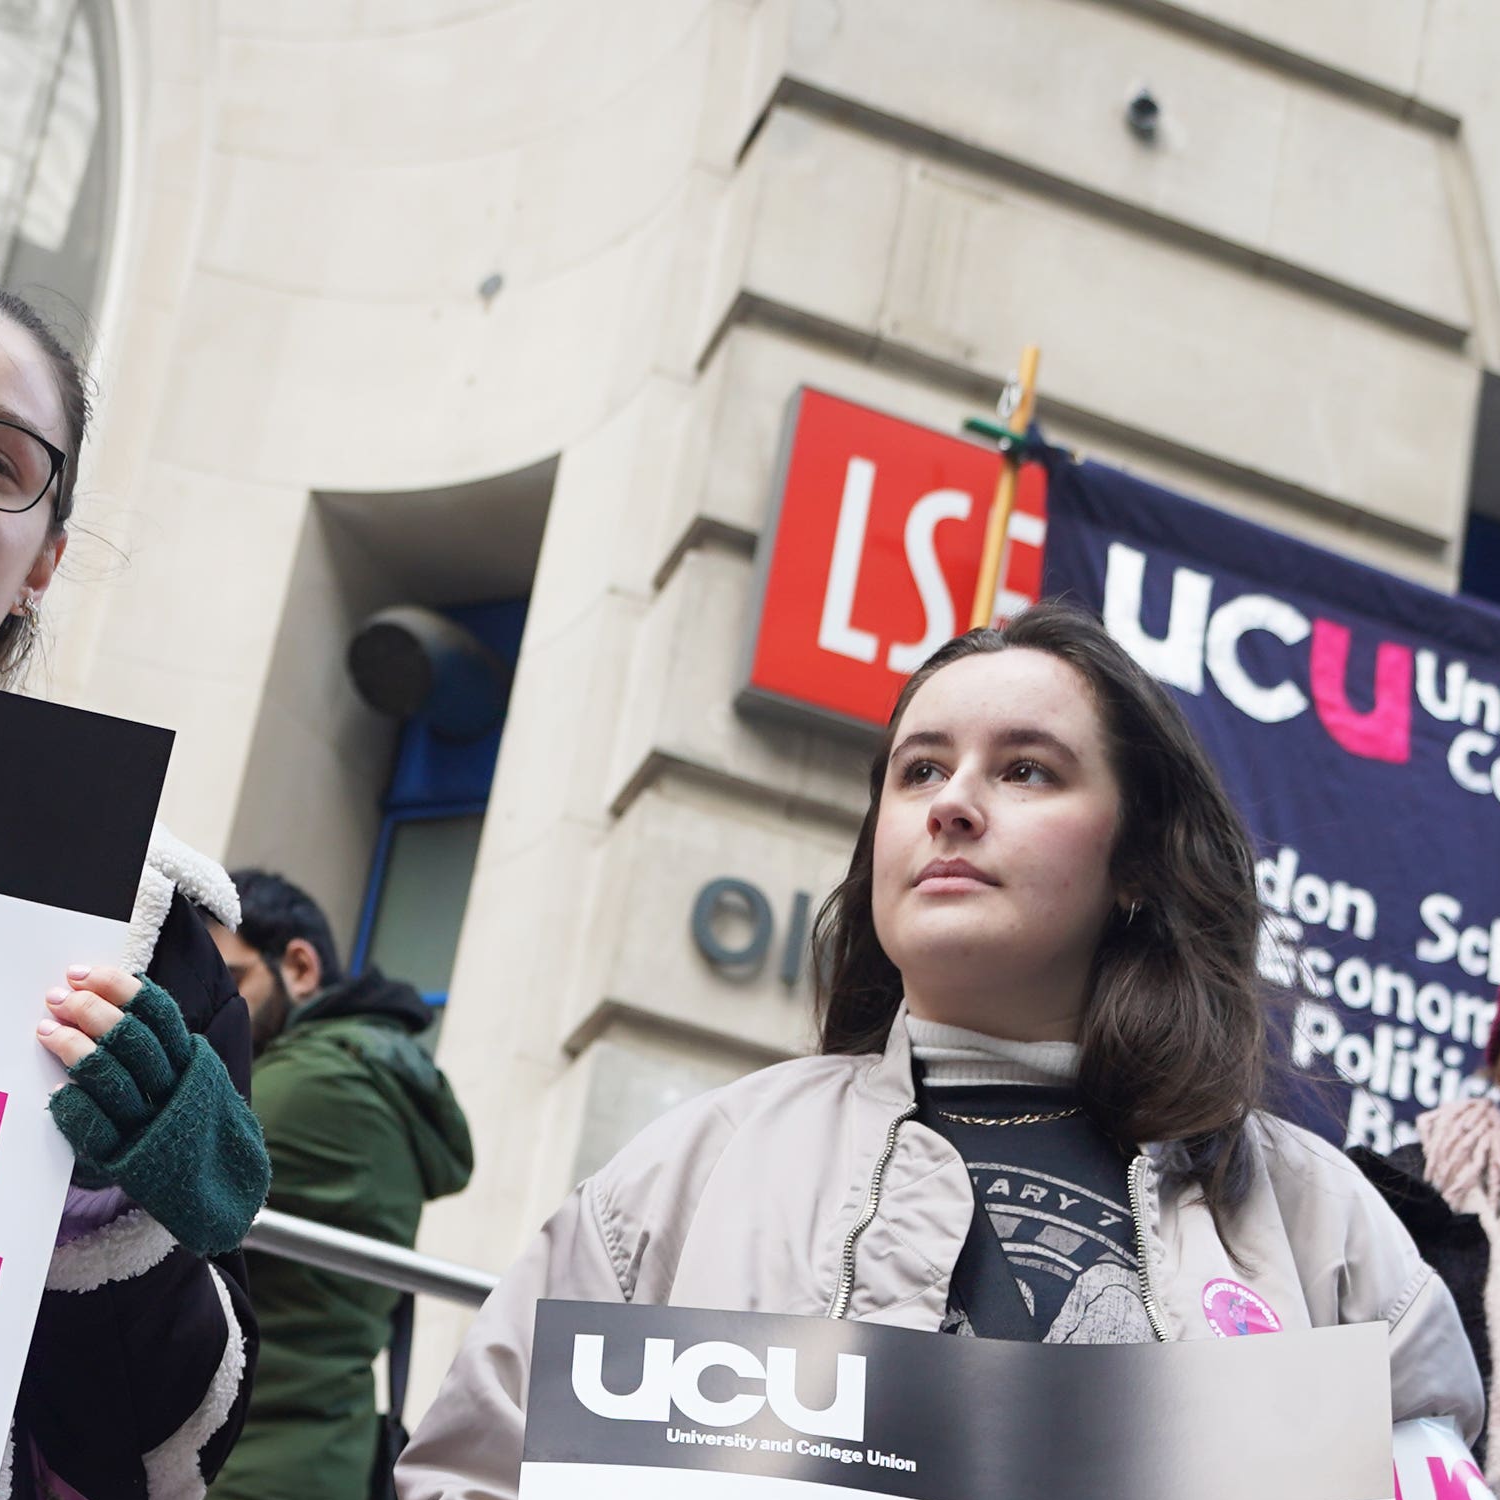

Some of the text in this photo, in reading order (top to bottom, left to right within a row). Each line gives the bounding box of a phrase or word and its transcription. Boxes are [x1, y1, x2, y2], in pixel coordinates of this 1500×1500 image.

[1254, 848, 1377, 941] don
[1254, 913, 1498, 1049] Econom
[666, 1428, 917, 1472] University and College Union
